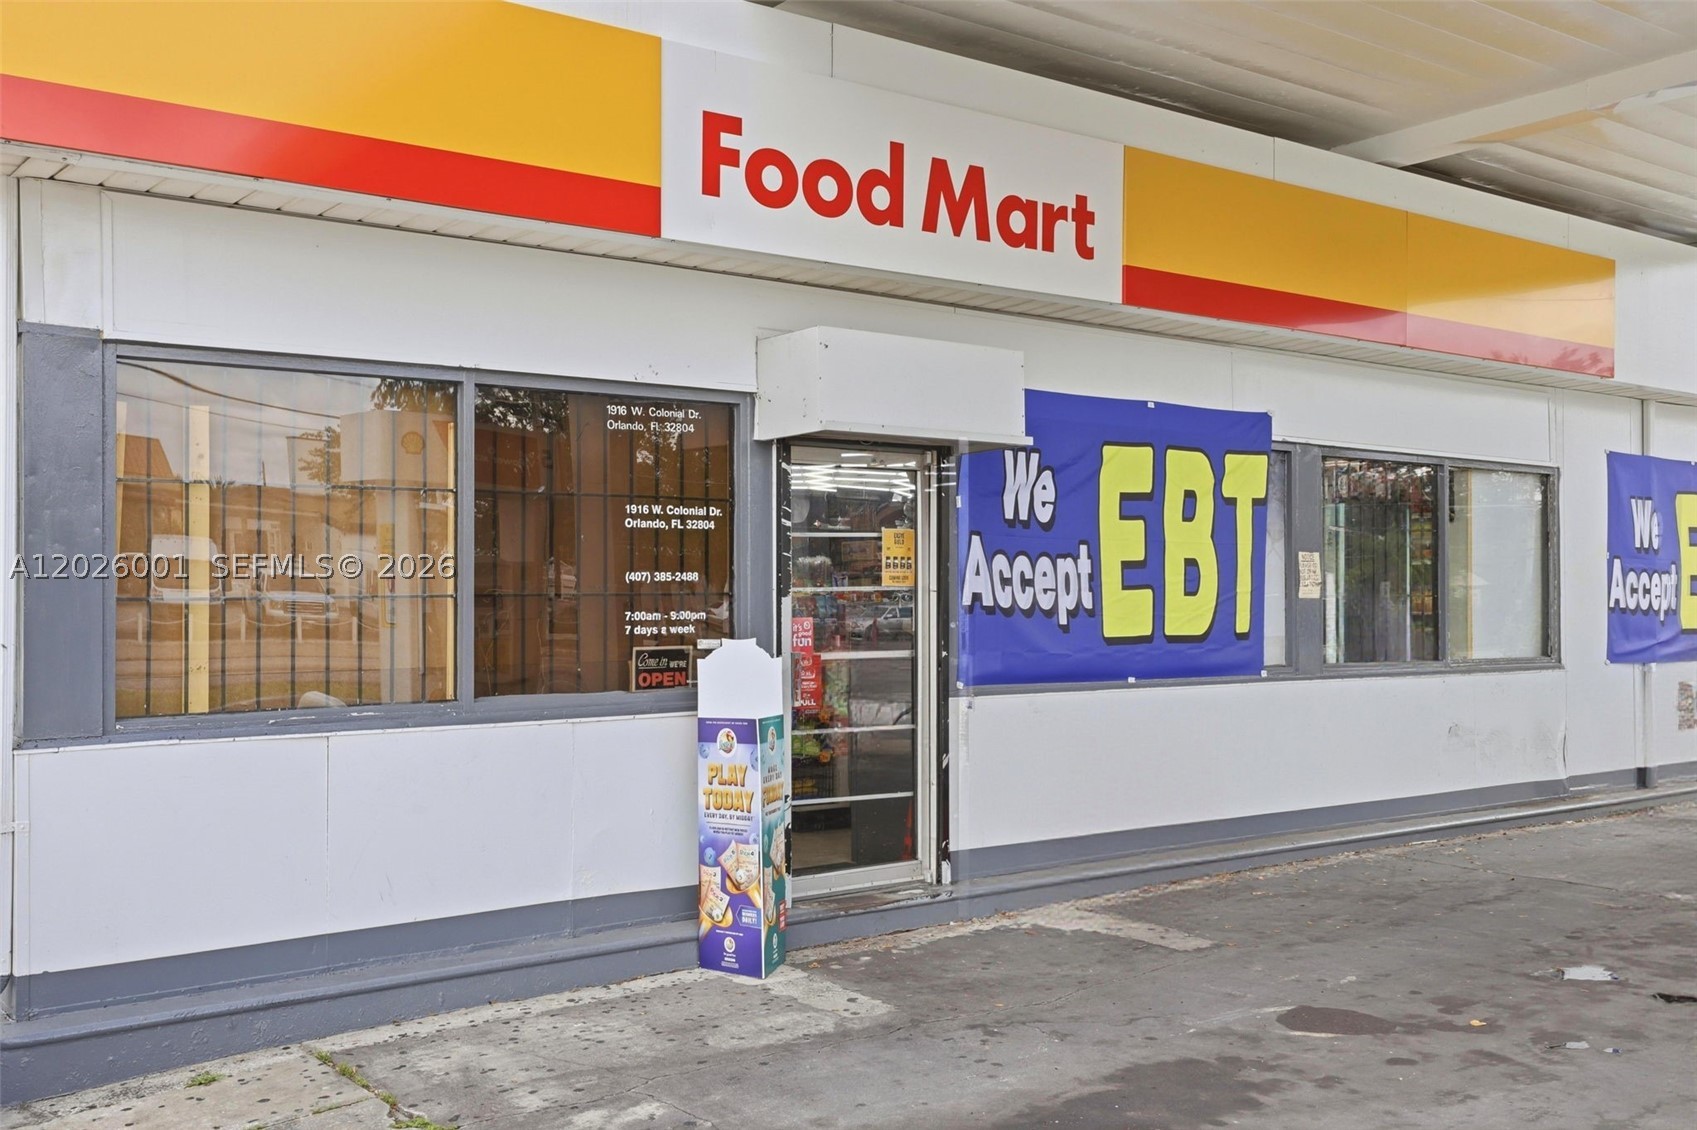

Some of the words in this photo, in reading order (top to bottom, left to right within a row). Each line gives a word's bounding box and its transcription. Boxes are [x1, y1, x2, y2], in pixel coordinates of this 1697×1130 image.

[701, 110, 904, 228] Food
[921, 157, 1096, 260] Mart
[606, 404, 627, 416] 1916
[631, 406, 645, 417] W.
[649, 407, 685, 419] Colonial
[688, 409, 702, 420] Dr.
[606, 419, 647, 432] Orlando,
[664, 422, 695, 433] 32804
[624, 504, 649, 515] 1916
[652, 505, 664, 515] W.
[666, 505, 707, 516] Colonial
[709, 506, 723, 516] Dr.
[624, 518, 669, 531] Orlando,
[671, 519, 684, 529] FL
[686, 519, 715, 530] 32804
[1631, 496, 1662, 551] We
[1002, 449, 1056, 526] We
[1099, 442, 1269, 641] EBT
[625, 571, 651, 583] (407)
[653, 572, 699, 582] 385-2488
[962, 533, 1094, 626] Accept
[1608, 557, 1678, 622] Accept
[625, 611, 662, 621] 7:00am
[670, 611, 707, 622] 9:00pm
[625, 625, 631, 635] 7
[634, 625, 658, 636] days
[661, 626, 667, 634] a
[669, 624, 696, 634] week
[792, 634, 812, 647] fun
[637, 652, 659, 668] Come
[659, 657, 668, 667] in
[669, 660, 687, 668] WE'RE
[638, 671, 687, 688] OPEN
[707, 763, 748, 787] PLAY
[703, 788, 754, 814] TODAY
